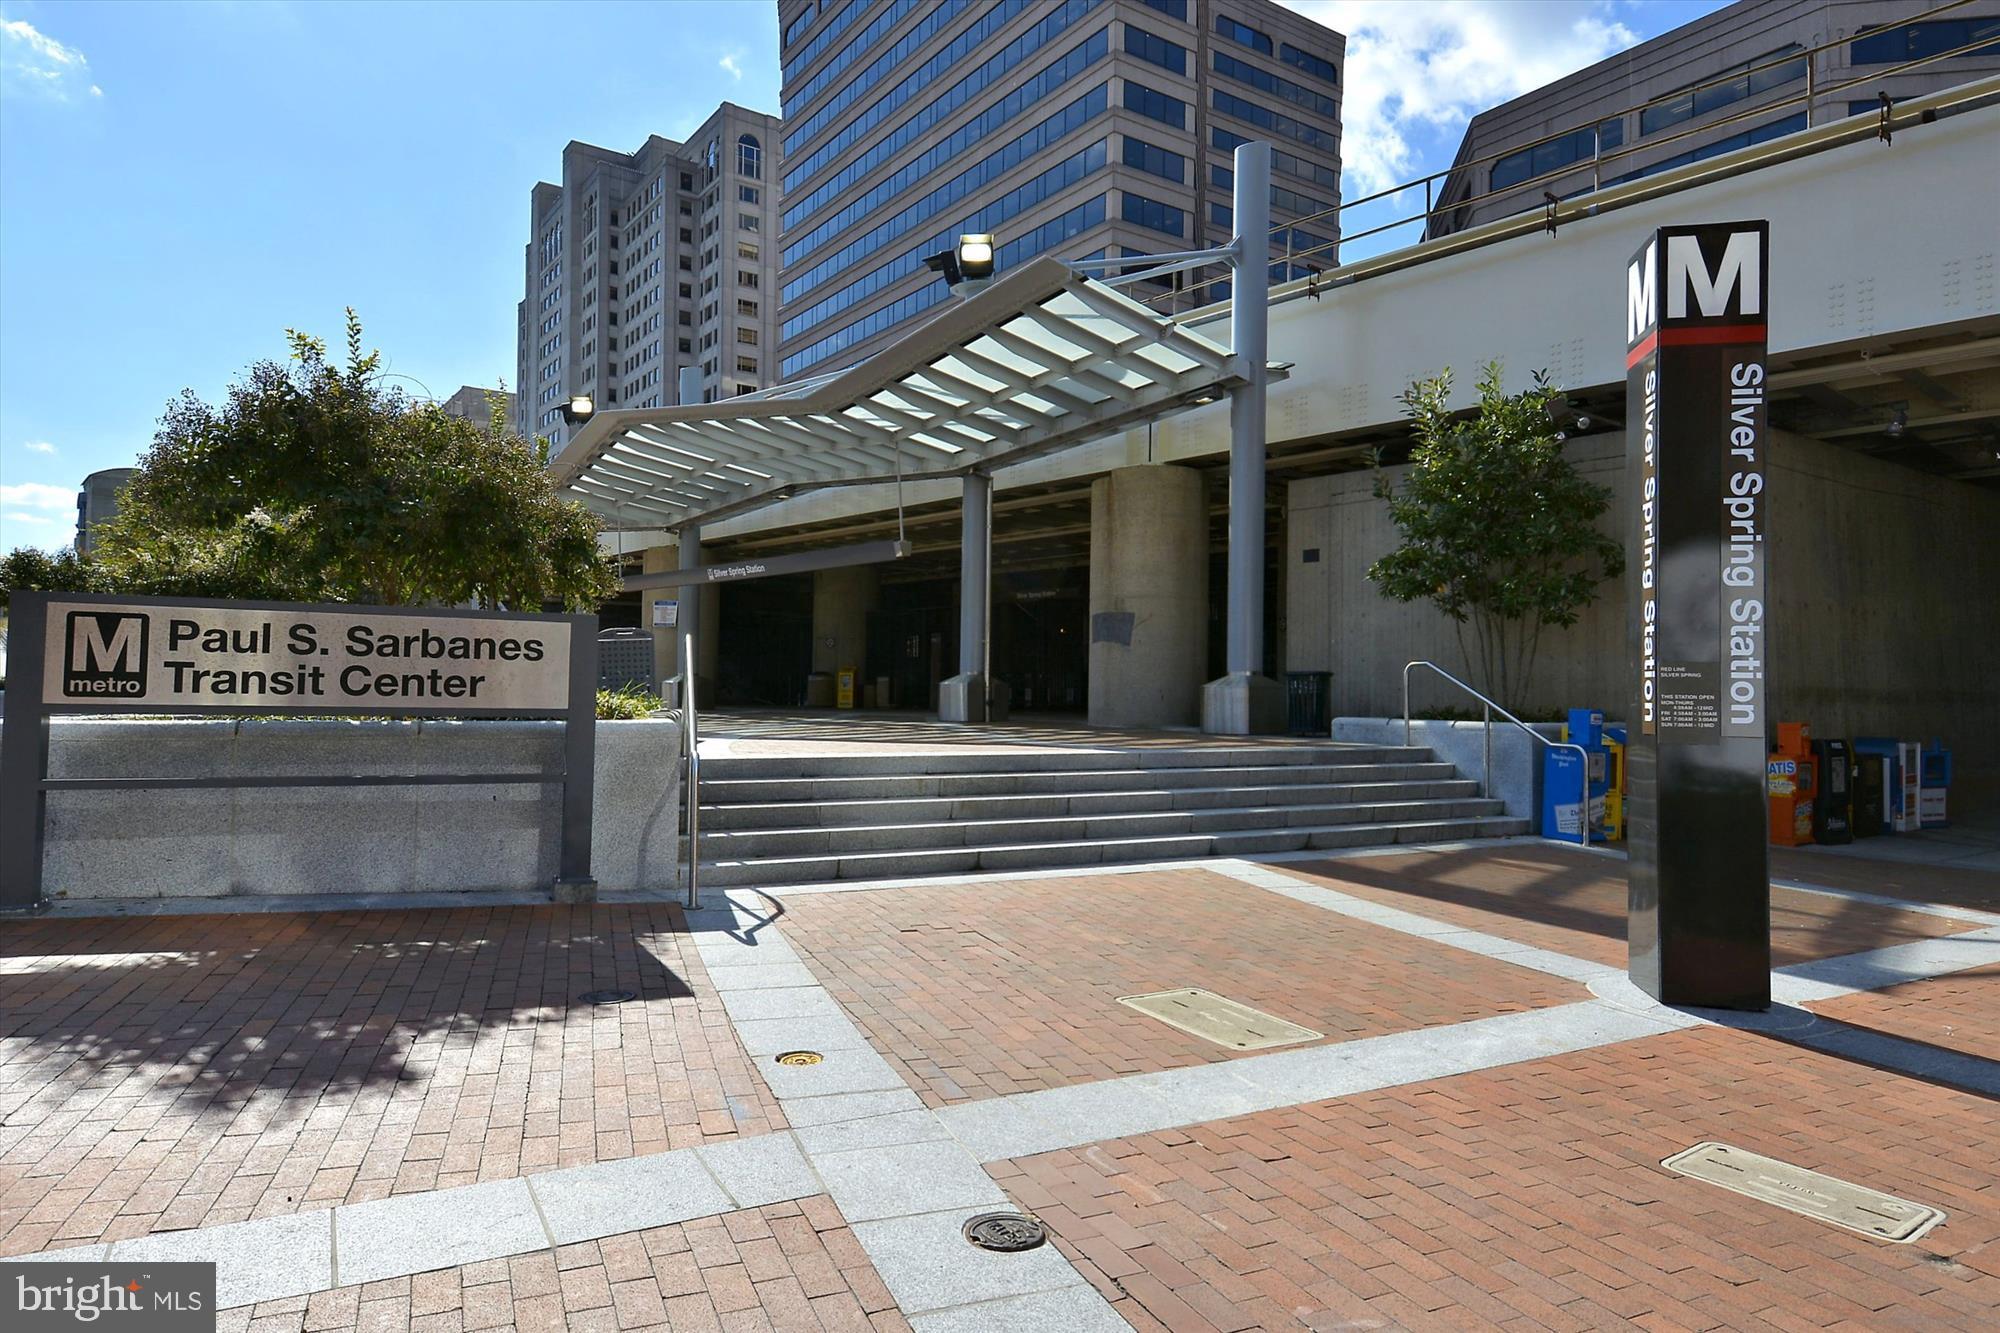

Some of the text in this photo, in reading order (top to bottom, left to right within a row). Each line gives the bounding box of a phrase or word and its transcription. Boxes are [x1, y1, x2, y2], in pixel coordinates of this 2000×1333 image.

[1628, 240, 1656, 345] M
[1667, 231, 1760, 319] M
[745, 564, 766, 573] Station
[1642, 370, 1656, 722] Silver Spring Station
[1723, 362, 1763, 725] Silver Spring Station
[72, 616, 143, 673] M
[169, 619, 544, 662] Paul S. Sarbanes
[69, 677, 141, 693] metro
[164, 661, 485, 697] Transit Center
[1768, 760, 1796, 774] ATIS
